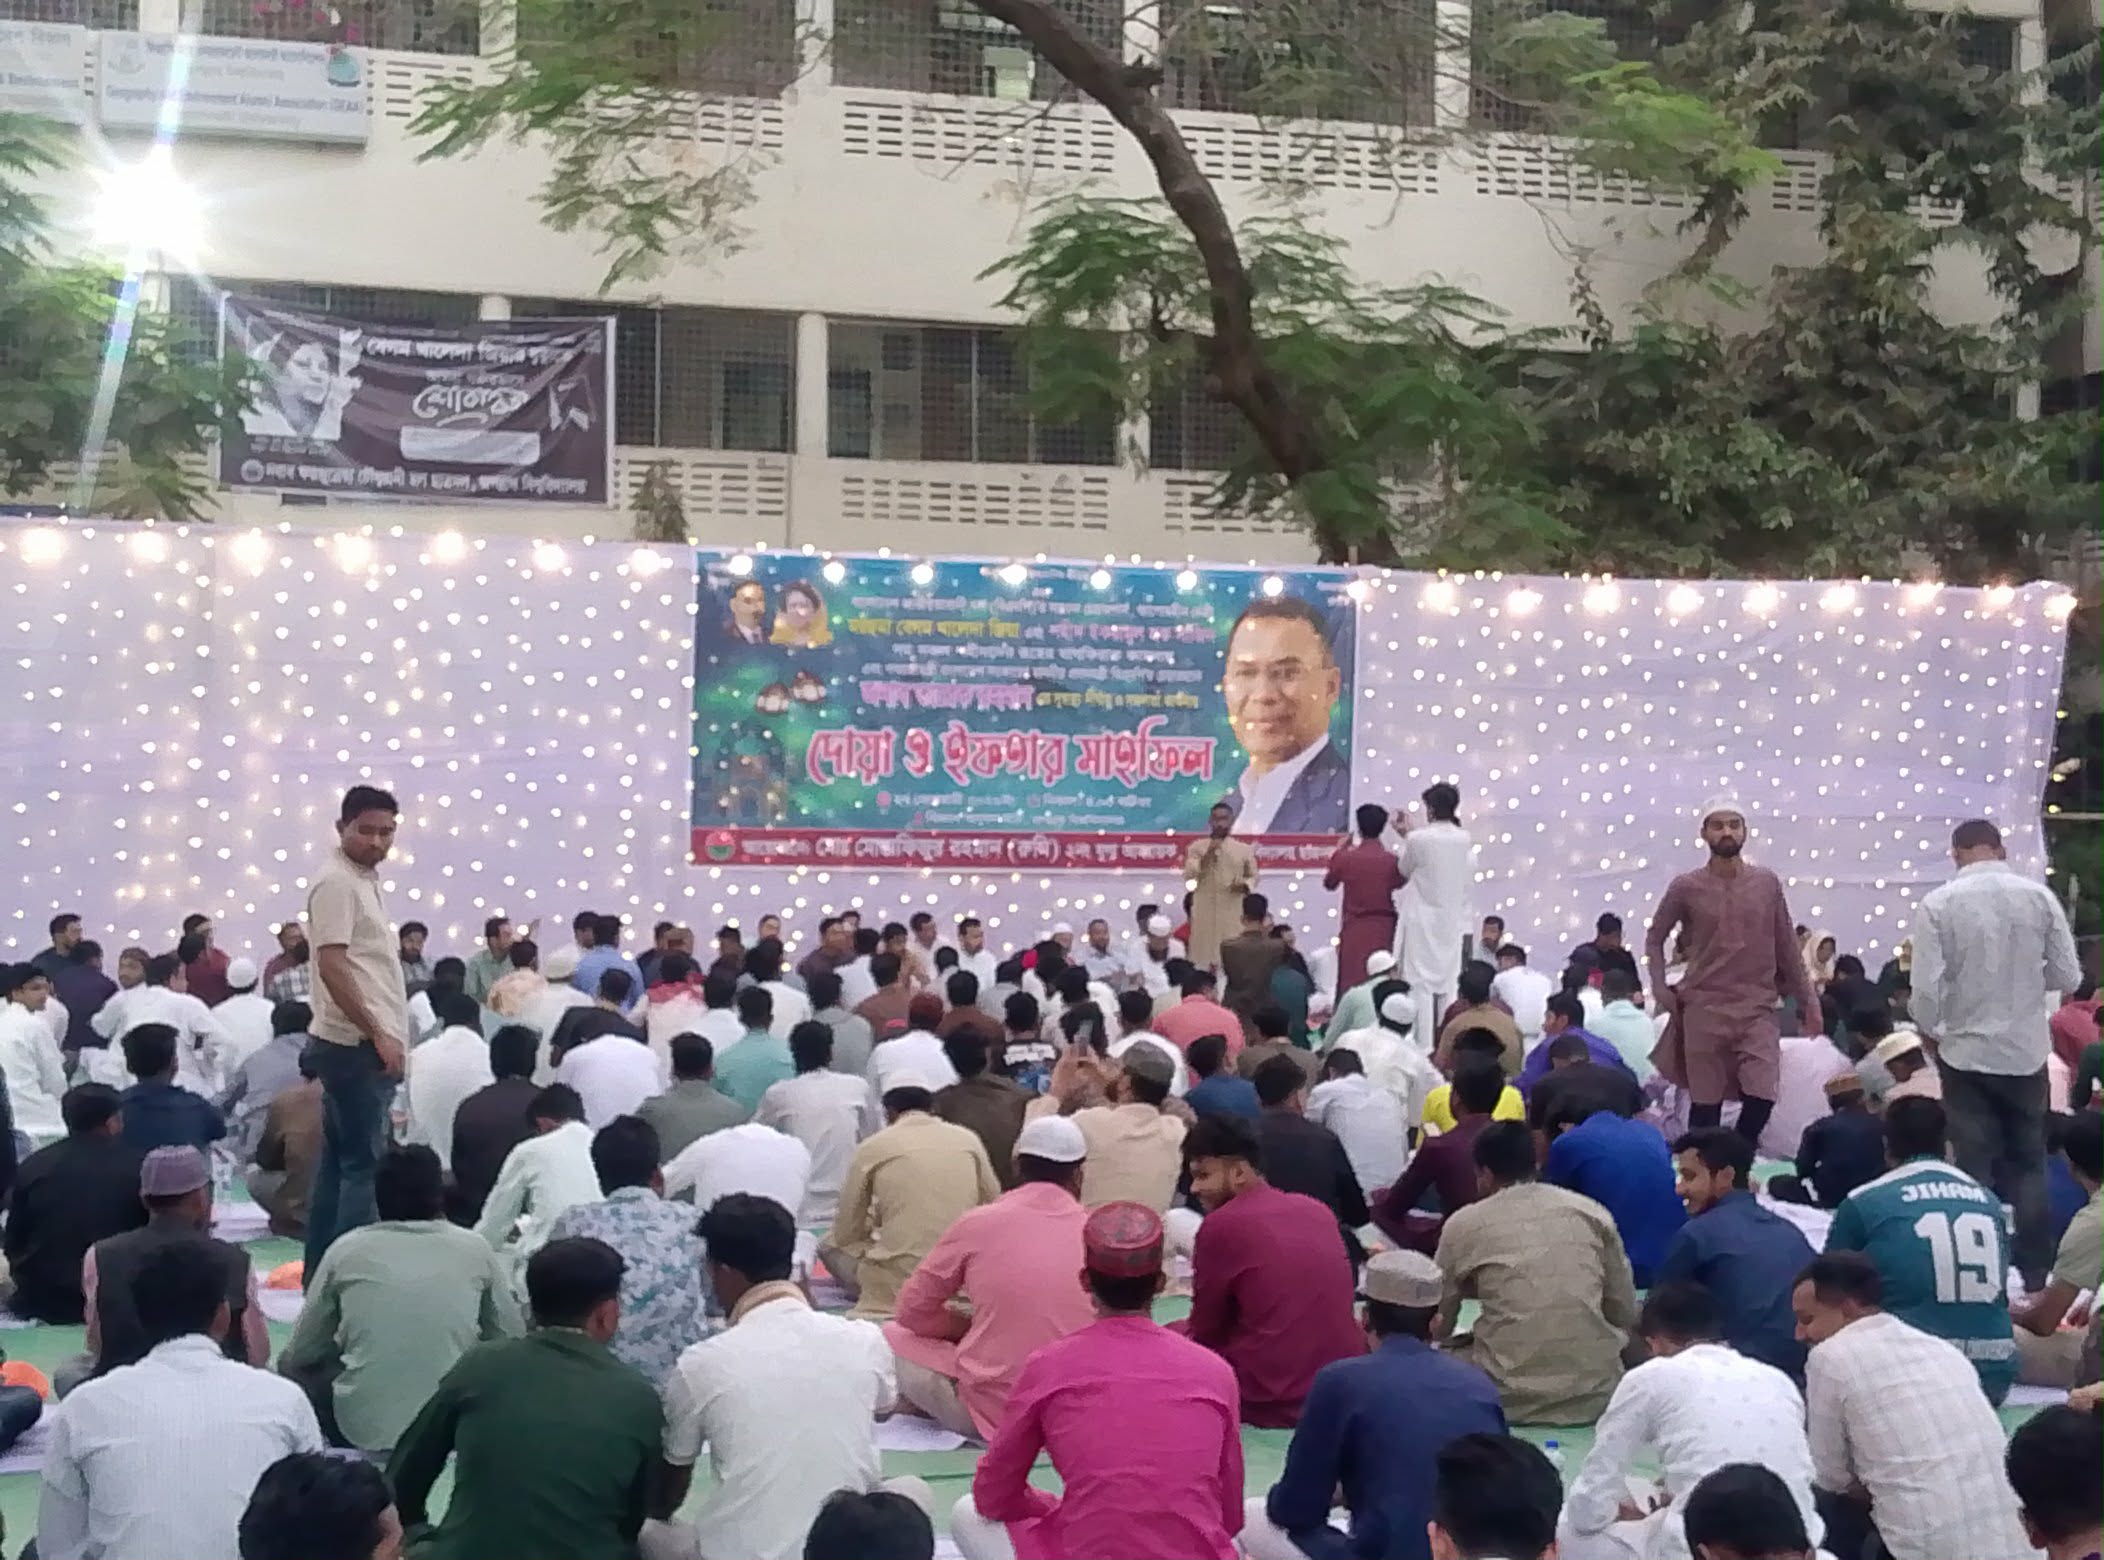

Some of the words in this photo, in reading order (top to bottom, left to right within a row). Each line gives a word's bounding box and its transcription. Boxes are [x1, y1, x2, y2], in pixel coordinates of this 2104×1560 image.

[806, 726, 896, 786] দোয়া
[903, 728, 932, 776] ও
[941, 720, 1068, 786] ইফতার
[1073, 714, 1217, 787] মাহফিল
[1914, 1211, 2003, 1304] 19
